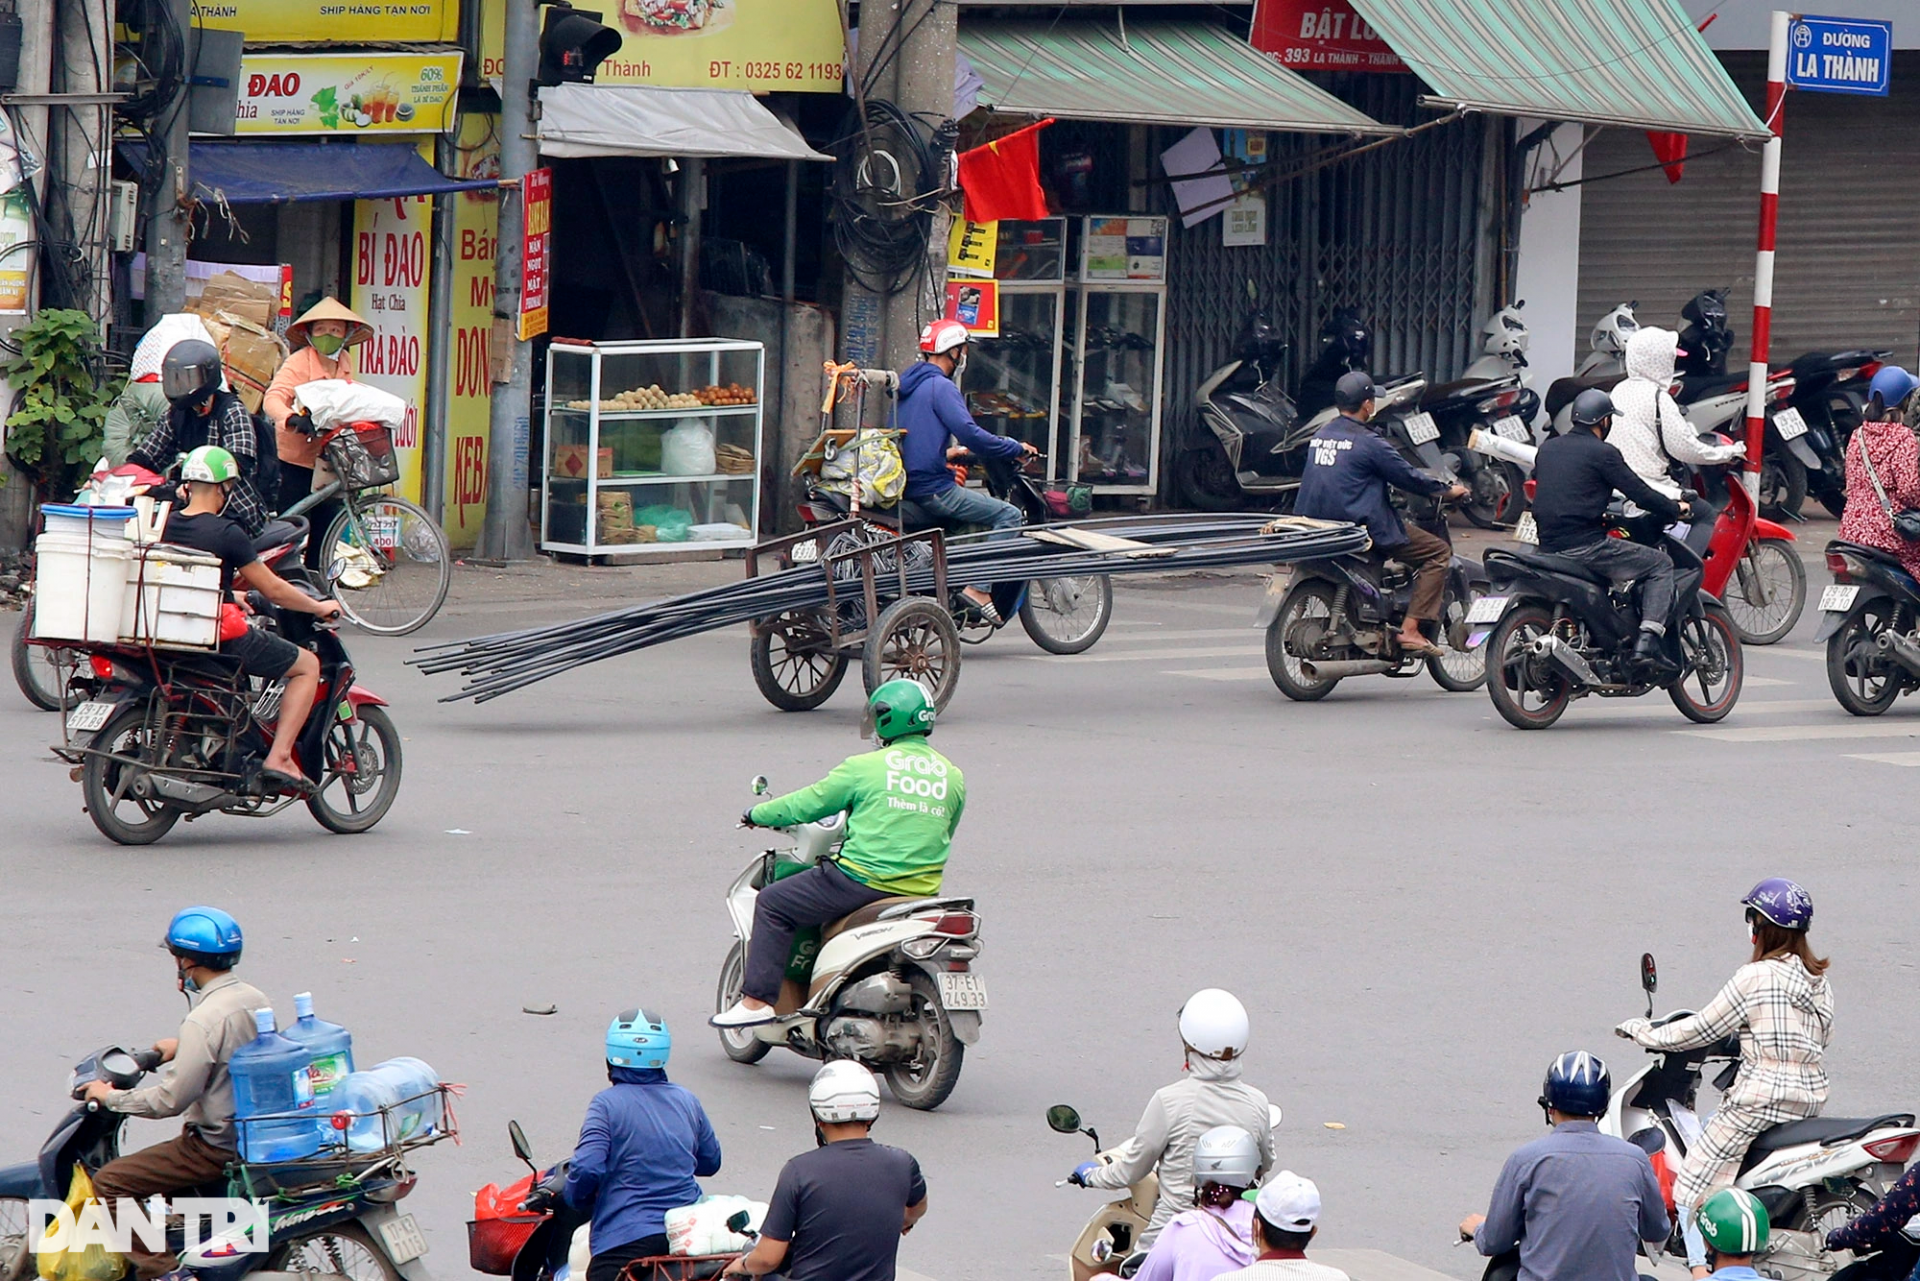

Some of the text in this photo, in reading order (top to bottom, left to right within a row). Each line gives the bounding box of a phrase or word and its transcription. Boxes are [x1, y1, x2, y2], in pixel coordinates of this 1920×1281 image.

[200, 6, 237, 17] THÀNH
[319, 6, 345, 15] SHIP
[348, 5, 381, 15] HÀNG
[410, 4, 431, 15] NƠI
[1300, 7, 1346, 45] BẬT
[1823, 28, 1871, 48] ĐƯỜNG
[1284, 48, 1311, 63] 393
[1313, 53, 1326, 63] LA
[1328, 51, 1359, 65] THÀNH
[1797, 50, 1880, 82] LA THÀNH
[420, 67, 443, 82] 60%
[603, 59, 651, 77] Thành
[709, 61, 733, 77] ĐT
[745, 62, 782, 79] 0325
[785, 63, 803, 79] 62
[808, 63, 843, 80] 1193
[247, 72, 301, 97] ĐAO
[236, 101, 258, 119] hia
[271, 109, 288, 117] SHIP
[358, 212, 425, 288] BÍ ĐAO
[371, 293, 406, 314] Hạt Chia
[358, 325, 420, 377] TRÀ ĐÀO
[1314, 448, 1338, 467] VGS
[885, 750, 948, 778] Grab
[886, 770, 948, 800] Food
[886, 796, 917, 812] Thèm
[919, 801, 929, 814] là
[946, 975, 980, 991] 37-E1
[944, 992, 987, 1008] 249.33
[1699, 1211, 1718, 1238] Grab
